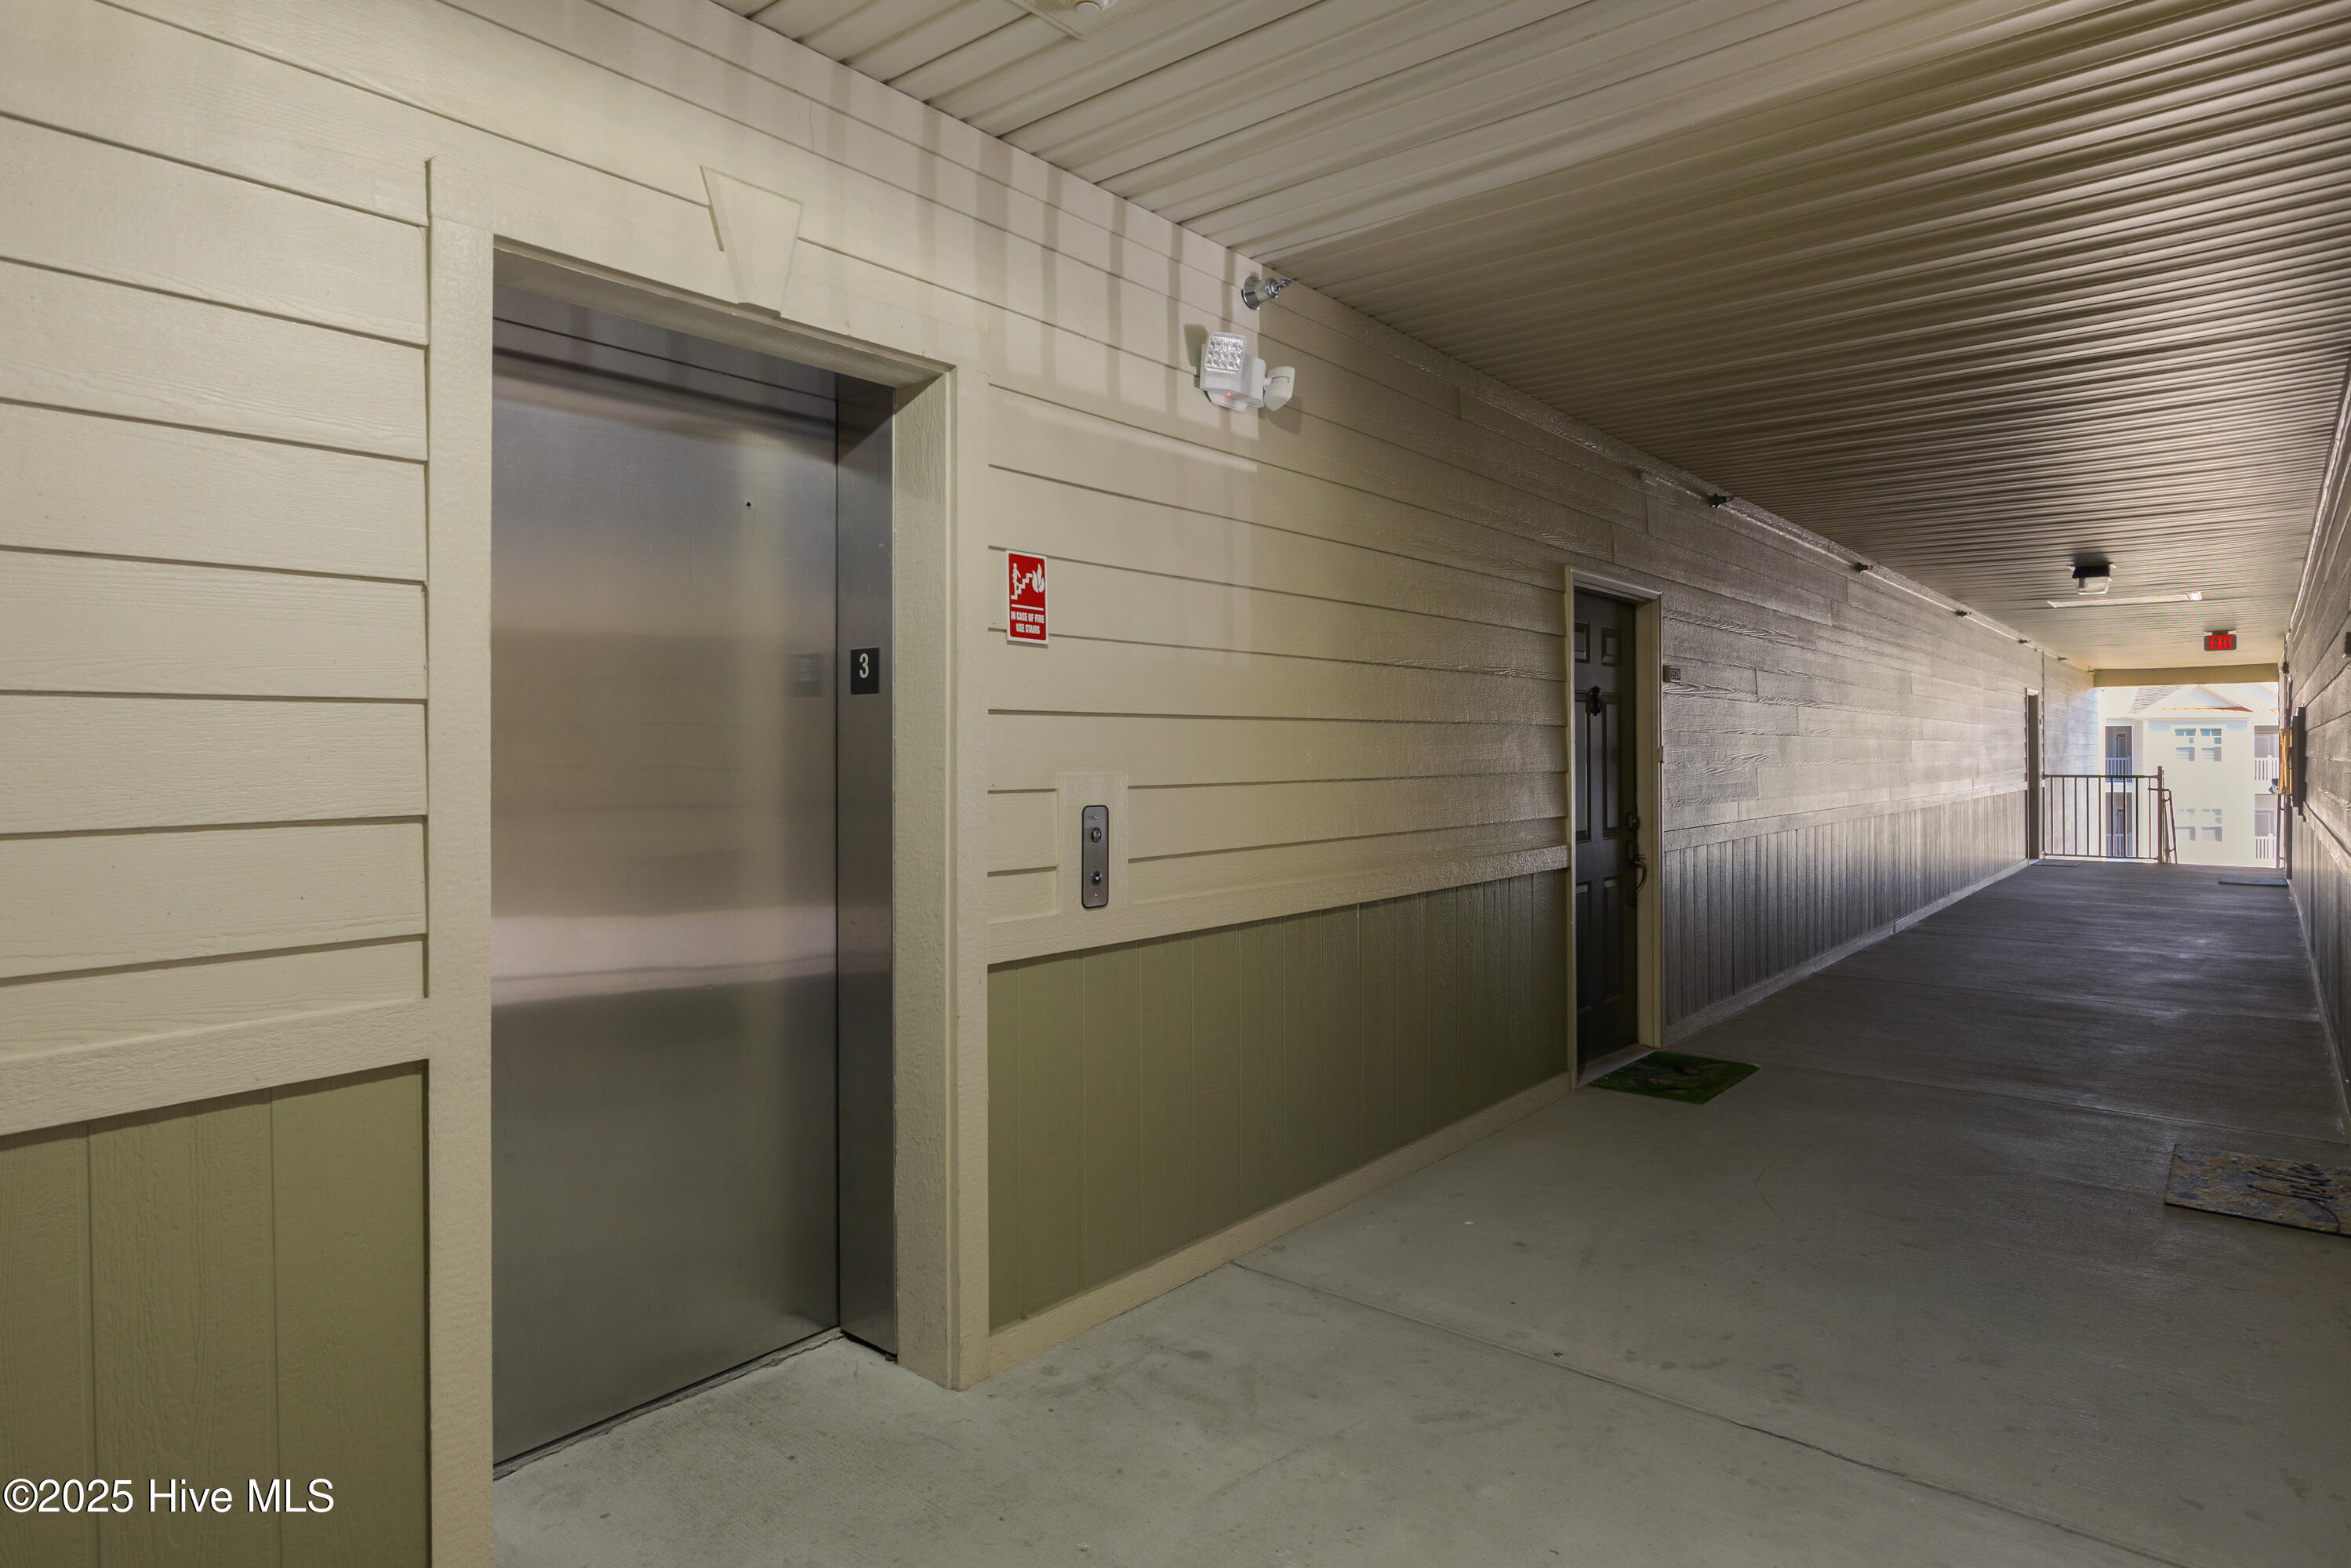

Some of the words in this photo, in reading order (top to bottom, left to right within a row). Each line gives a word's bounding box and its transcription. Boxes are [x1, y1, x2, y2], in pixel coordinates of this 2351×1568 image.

[1011, 611, 1016, 620] IN
[1016, 612, 1027, 622] CASE
[1028, 613, 1034, 622] OF
[1034, 614, 1045, 623] FIRE
[1016, 623, 1024, 633] USE
[1026, 624, 1040, 633] STAIRS
[2209, 634, 2233, 650] EXIT
[859, 653, 869, 678] 3
